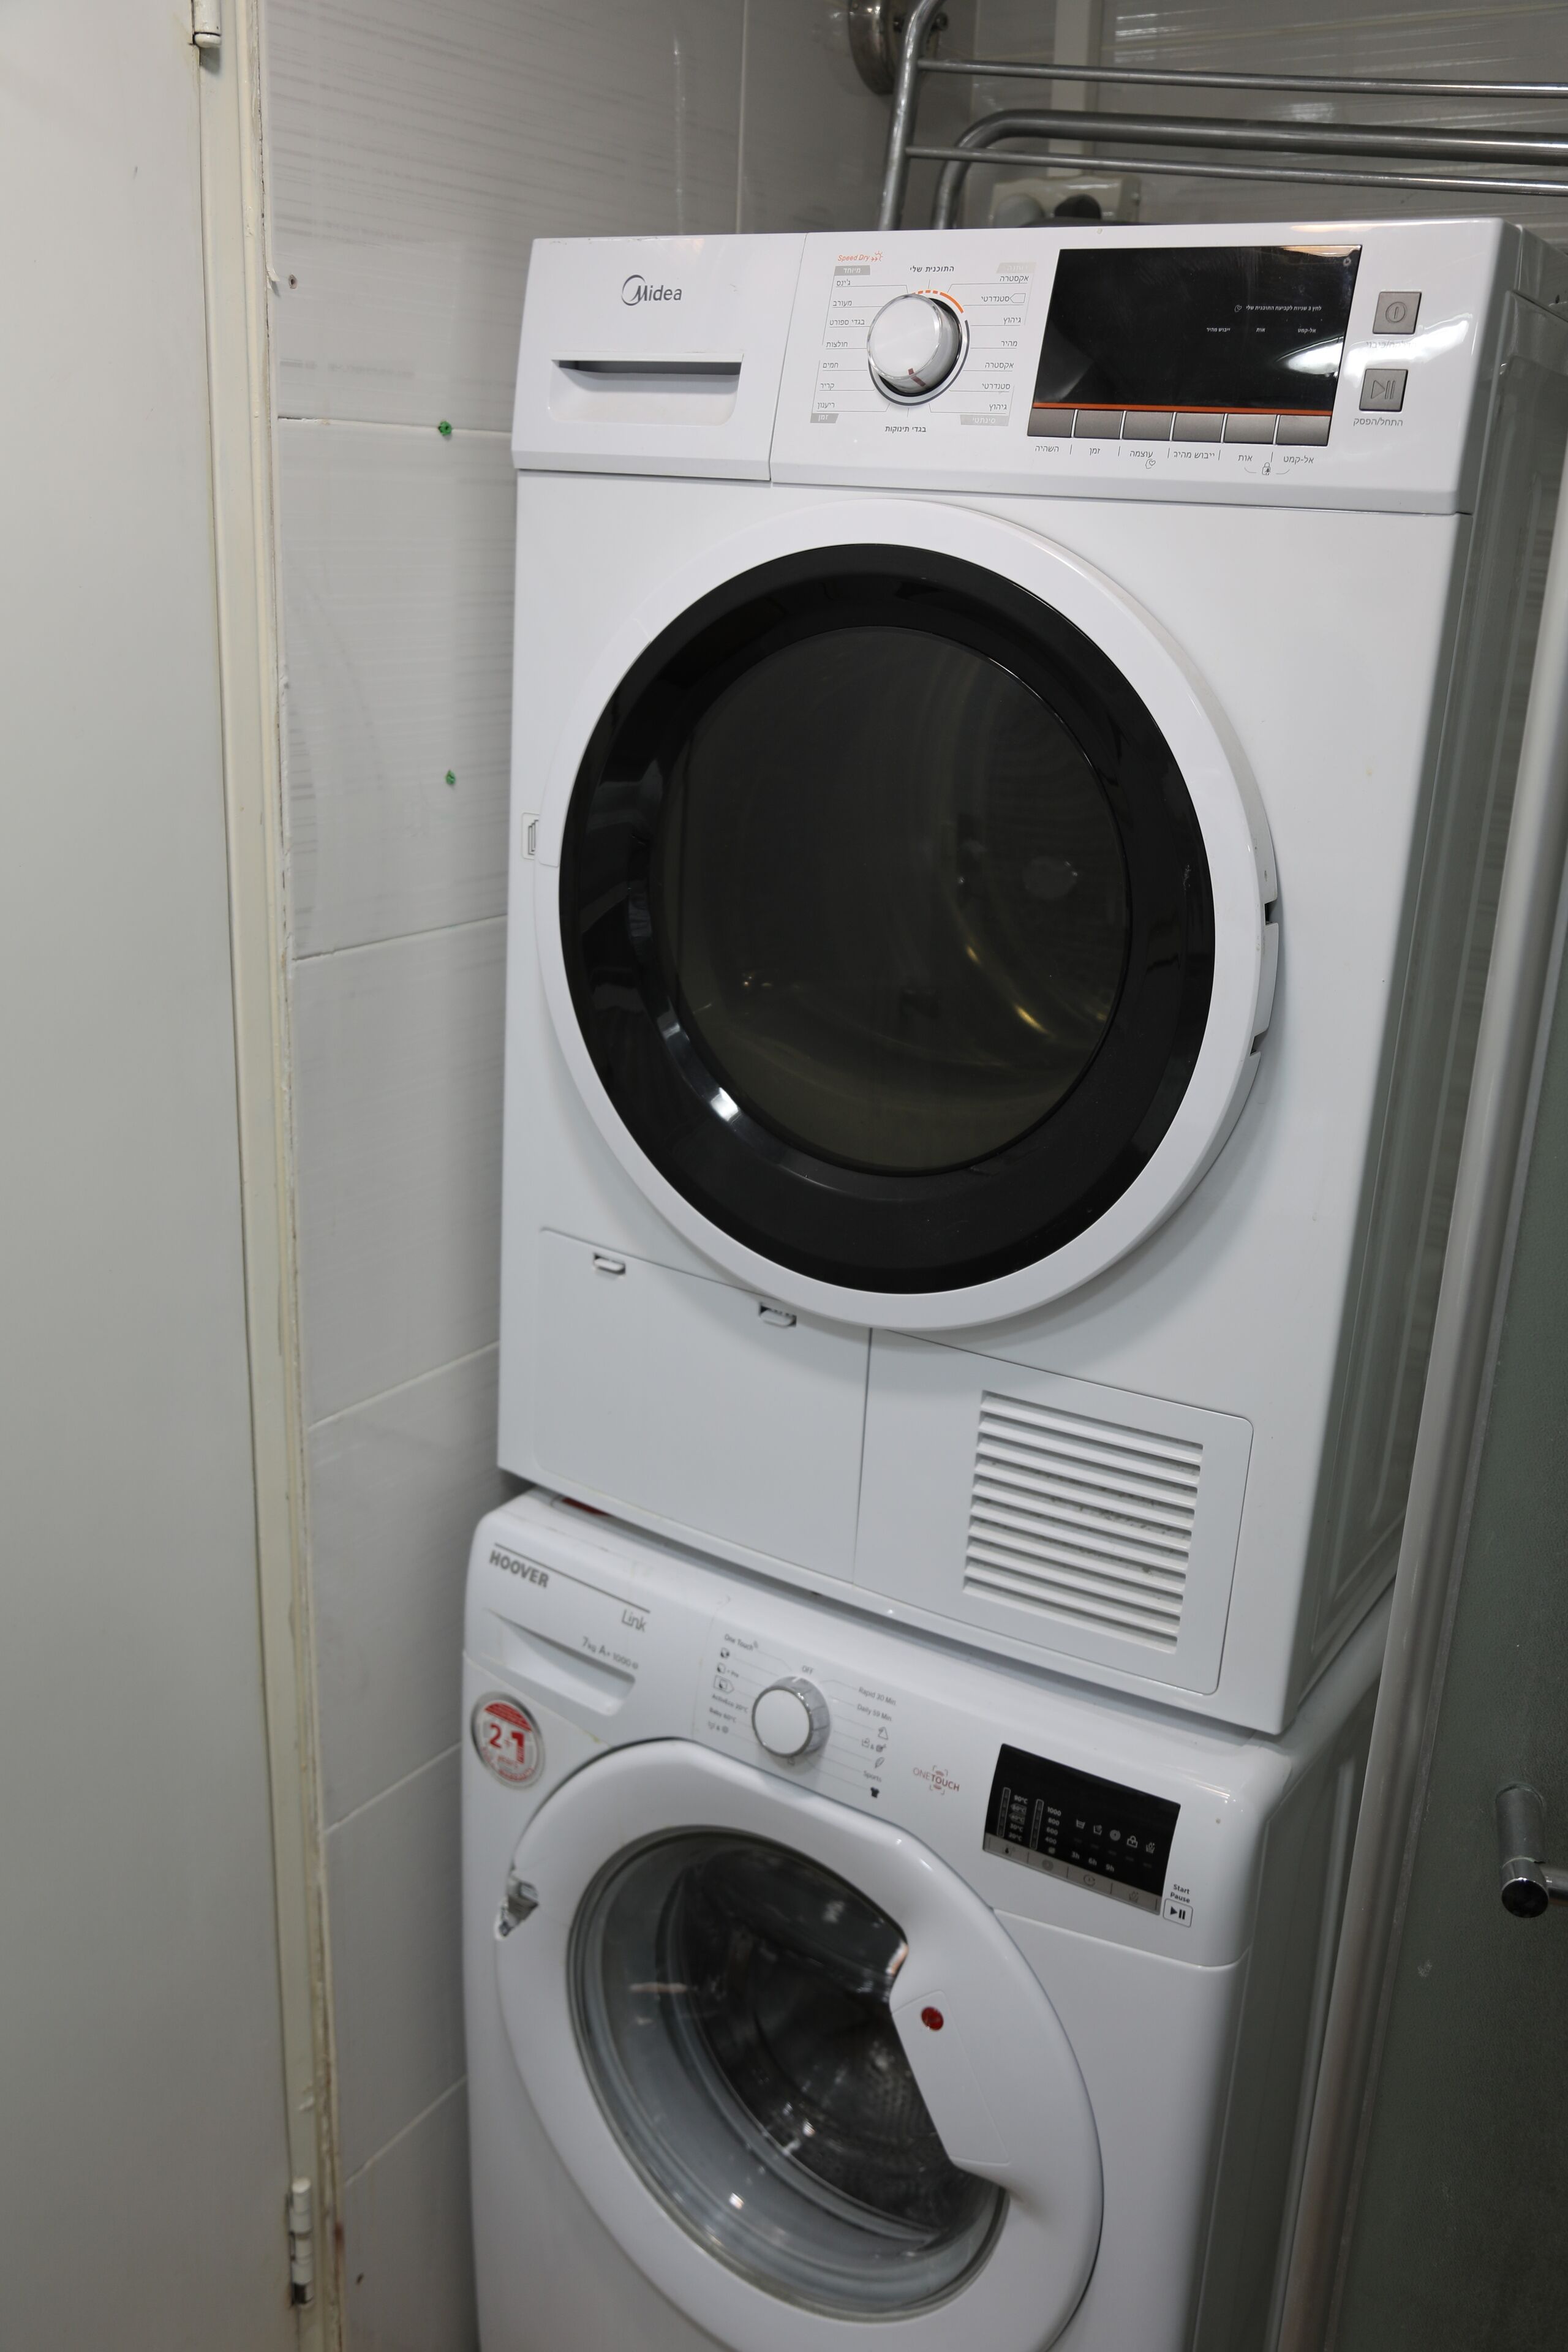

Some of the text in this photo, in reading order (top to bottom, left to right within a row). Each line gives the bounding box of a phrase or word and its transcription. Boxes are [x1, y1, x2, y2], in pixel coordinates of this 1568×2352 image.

[837, 254, 858, 263] Speed
[1000, 275, 1029, 284] אקסטרה
[624, 280, 682, 304] Midea
[1003, 316, 1022, 325] גיהוץ
[818, 413, 829, 422] זמן
[1353, 417, 1403, 427] התחל/הפסק
[1089, 447, 1101, 456] זמן
[1129, 450, 1153, 458] עוצמה
[1283, 454, 1314, 464] אל-קמט
[489, 1549, 549, 1588] HOOVER
[621, 1608, 647, 1632] Link
[724, 1633, 754, 1651] One Touch
[802, 1665, 814, 1675] OFF
[858, 1686, 876, 1698] Rapid
[876, 1694, 885, 1702] 30
[858, 1703, 872, 1715] Daily
[863, 1770, 883, 1783] Sports
[1047, 1806, 1062, 1817] 1000
[1047, 1817, 1060, 1826] 800
[1046, 1826, 1058, 1836] 600
[1044, 1836, 1057, 1845] 400
[1071, 1850, 1080, 1860] 3h
[1088, 1857, 1098, 1867] 6h
[1105, 1863, 1115, 1873] 9h
[1172, 1883, 1191, 1895] Start
[1170, 1891, 1191, 1904] Pause
